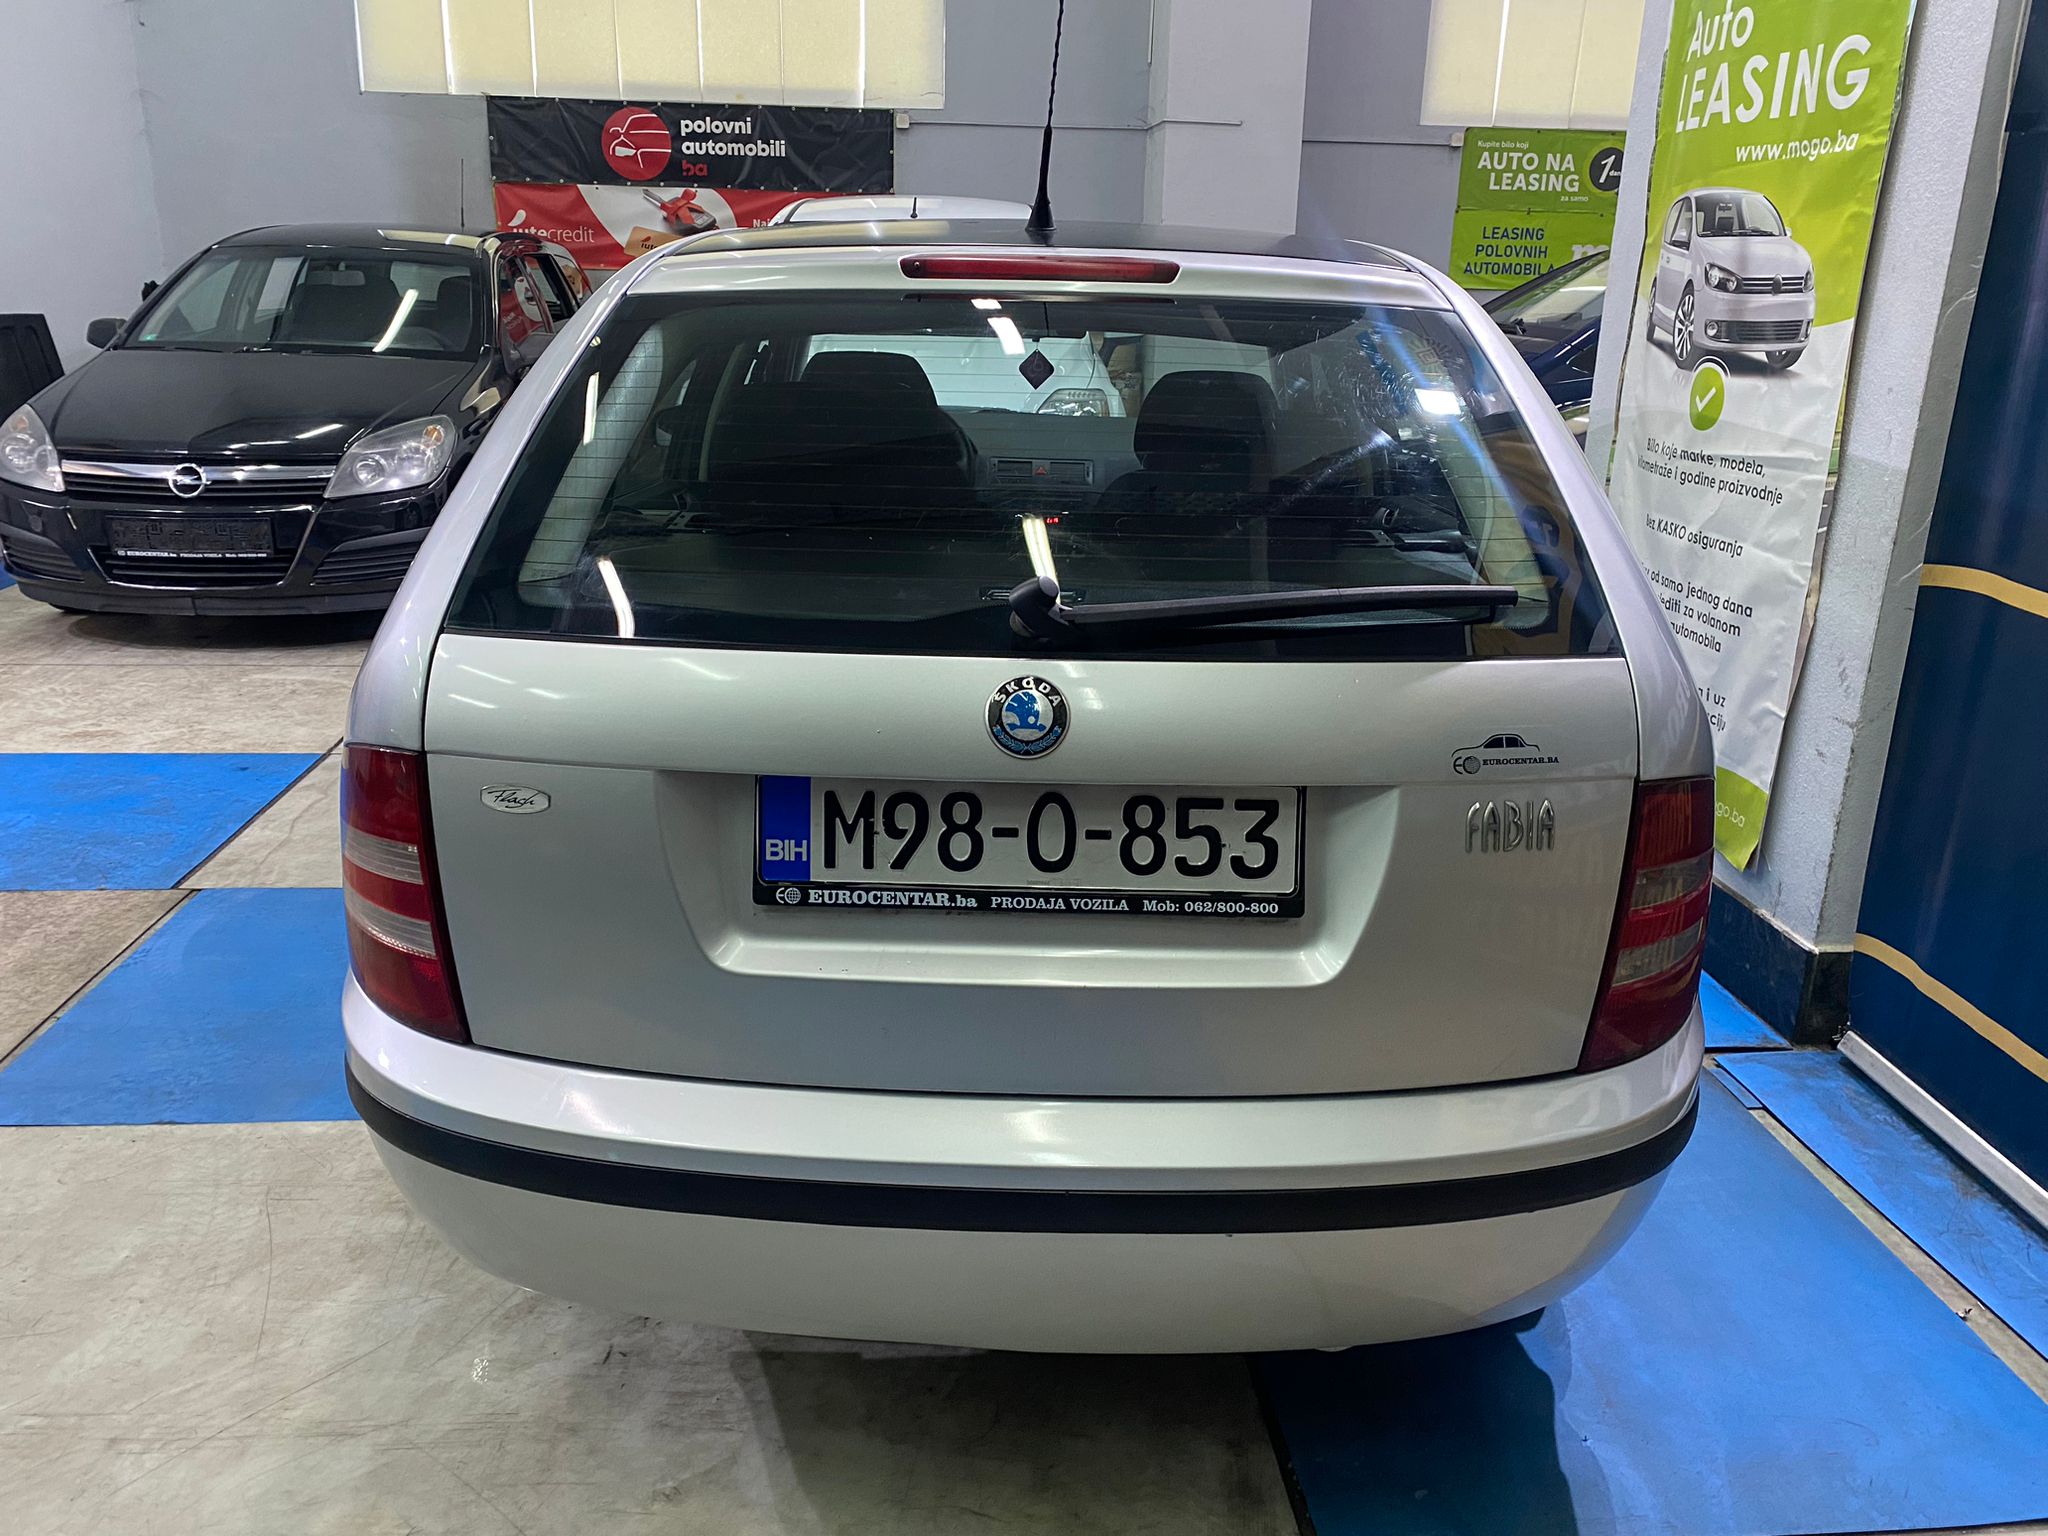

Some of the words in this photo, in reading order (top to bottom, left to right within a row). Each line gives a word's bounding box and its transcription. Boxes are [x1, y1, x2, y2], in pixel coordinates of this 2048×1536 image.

[1686, 0, 1754, 62] Auto
[1675, 34, 1872, 134] LEASING
[680, 116, 752, 136] polovni
[681, 139, 786, 157] automobili
[1477, 140, 1500, 149] Kupite
[1501, 141, 1515, 149] bilo
[1516, 142, 1529, 150] koji
[1735, 129, 1859, 162] www.mogo.ba
[682, 159, 708, 176] ba
[1477, 151, 1539, 171] AUTO
[1545, 153, 1575, 172] NA
[1599, 154, 1616, 184] 1
[1488, 172, 1580, 192] LEASING
[1482, 226, 1545, 241] LEASING
[1475, 244, 1549, 258] POLOVNIH
[1463, 262, 1556, 276] AUTOMOBILA
[1660, 441, 1678, 461] koje
[1680, 449, 1718, 468] marke,
[1720, 456, 1766, 479] modela,
[1674, 466, 1679, 480] i
[1680, 470, 1716, 486] godine
[1717, 478, 1783, 507] proizvodnje
[1656, 518, 1687, 540] KASKO
[1687, 530, 1743, 558] osiguranja
[1651, 570, 1661, 583] od
[1661, 575, 1684, 593] samo
[1686, 581, 1720, 610] jednog
[1722, 596, 1753, 618] dana
[1683, 605, 1694, 619] za
[1697, 610, 1741, 637] volanom
[1713, 693, 1726, 708] uz
[1481, 756, 1560, 767] EUROCENTAR.BA
[1464, 799, 1555, 853] FABIA
[1714, 801, 1746, 829] go.ba
[764, 838, 808, 861] BIH
[808, 888, 978, 909] EUROCENTAR.ba
[991, 896, 1066, 911] PRODAJA
[1070, 898, 1130, 912] VOZILA
[1142, 899, 1180, 913] Mob:
[1184, 900, 1279, 915] 062/800-800
